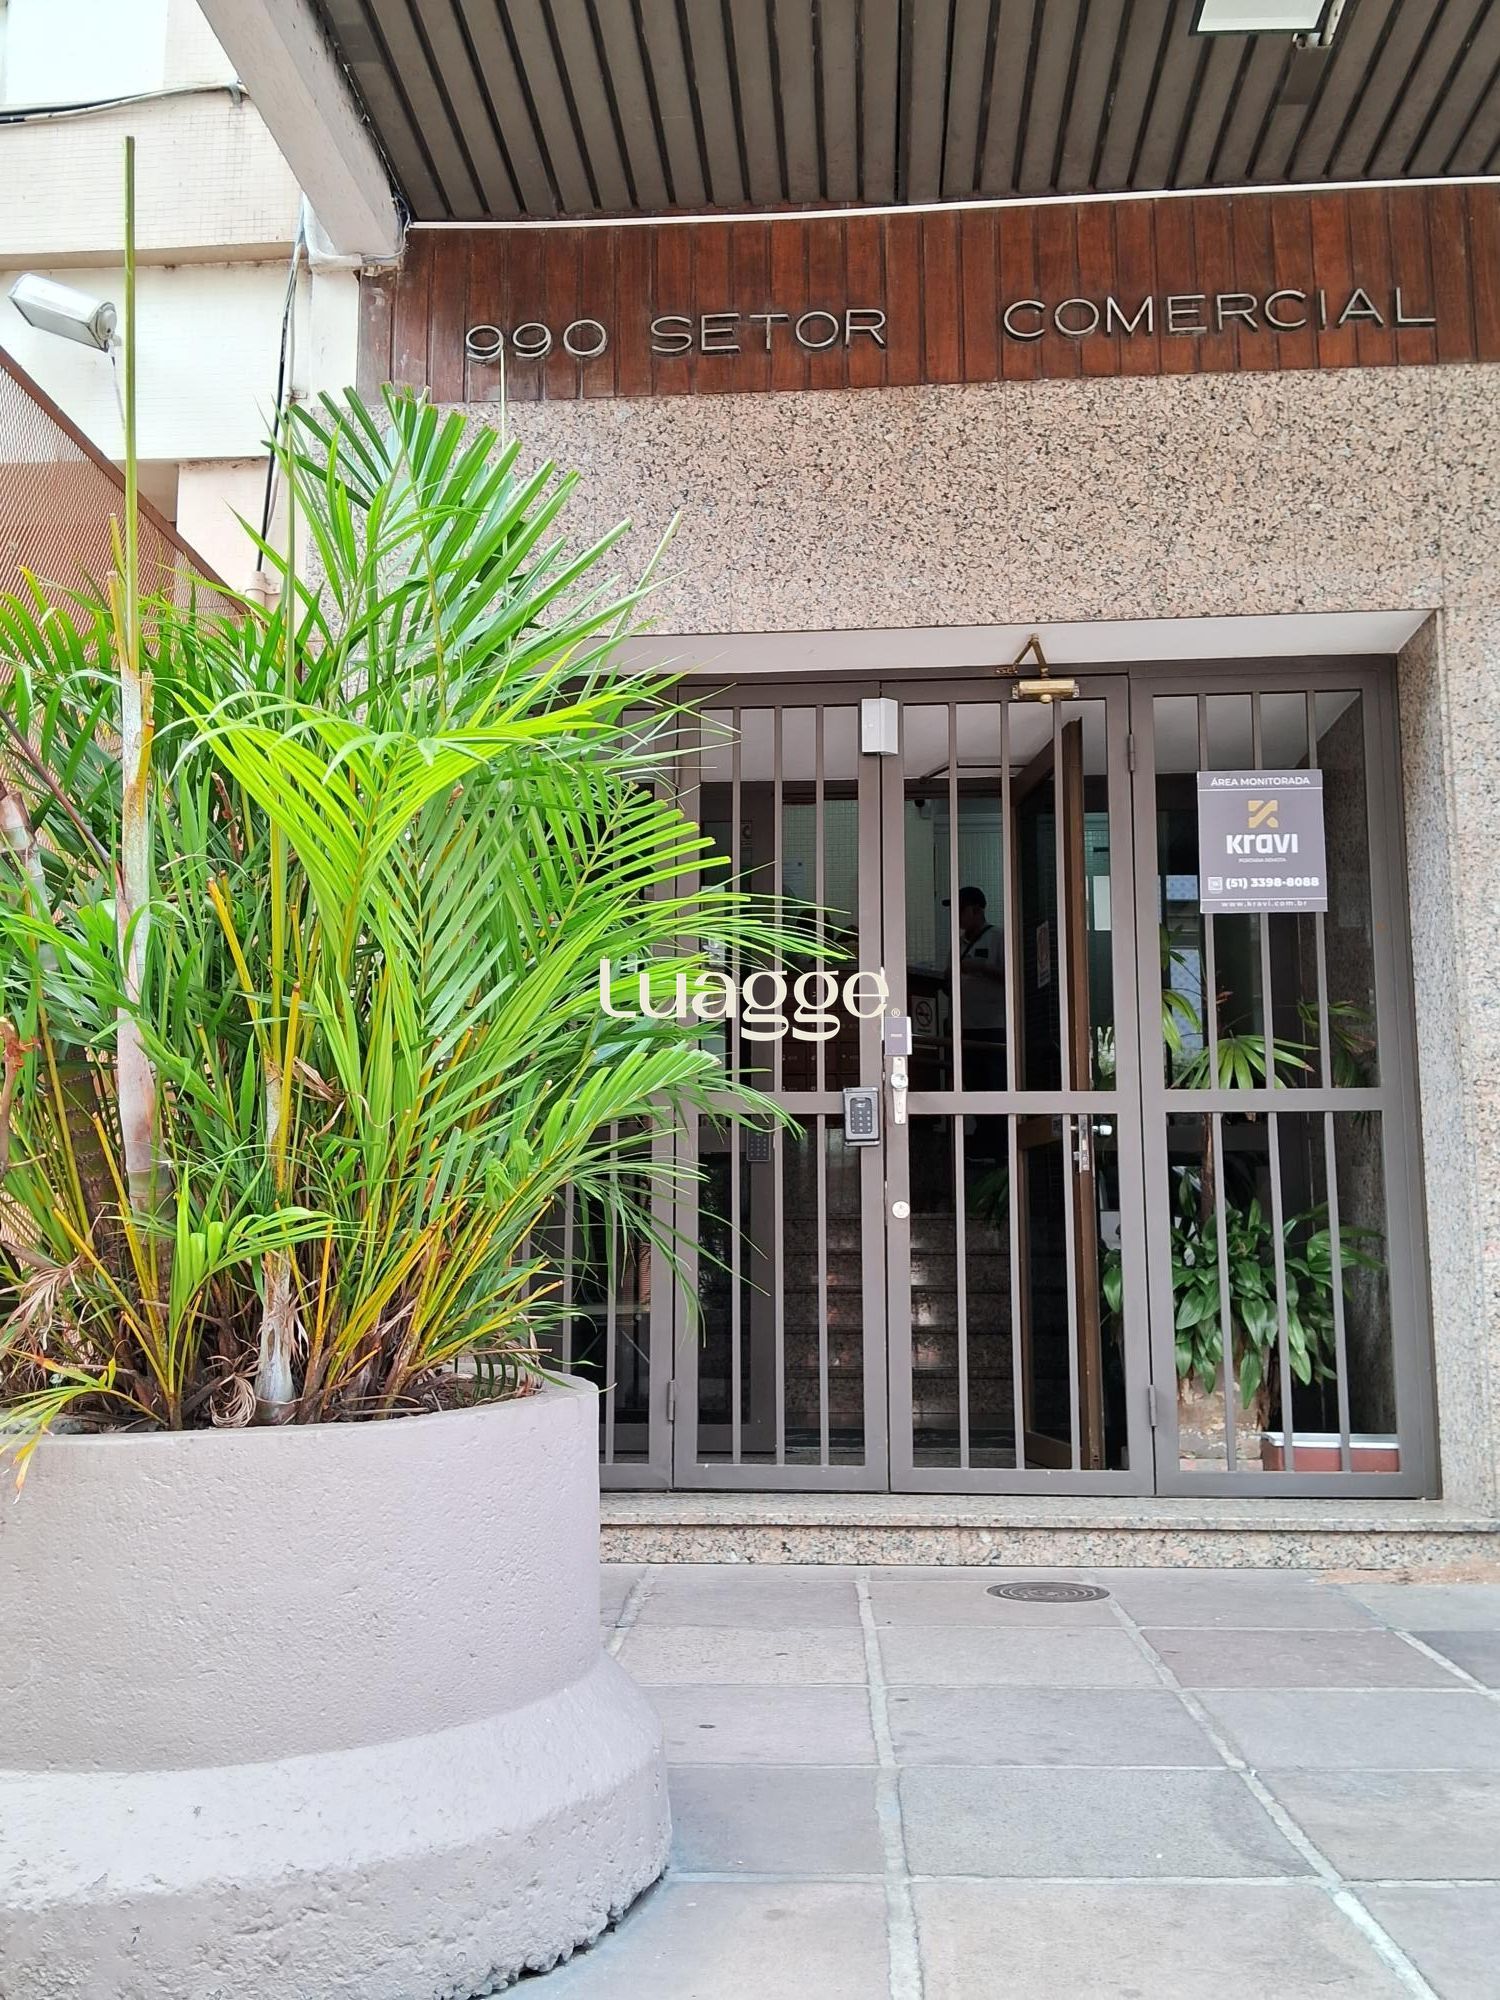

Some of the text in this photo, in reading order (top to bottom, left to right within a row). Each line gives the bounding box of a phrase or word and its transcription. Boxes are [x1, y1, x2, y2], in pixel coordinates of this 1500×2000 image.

[465, 287, 1437, 361] 990 SETOR COMERCIAL
[1210, 776, 1310, 787] ÁREA MONITORADA
[1225, 878, 1248, 889] (51)
[1221, 900, 1308, 908] www.kravi.com.br
